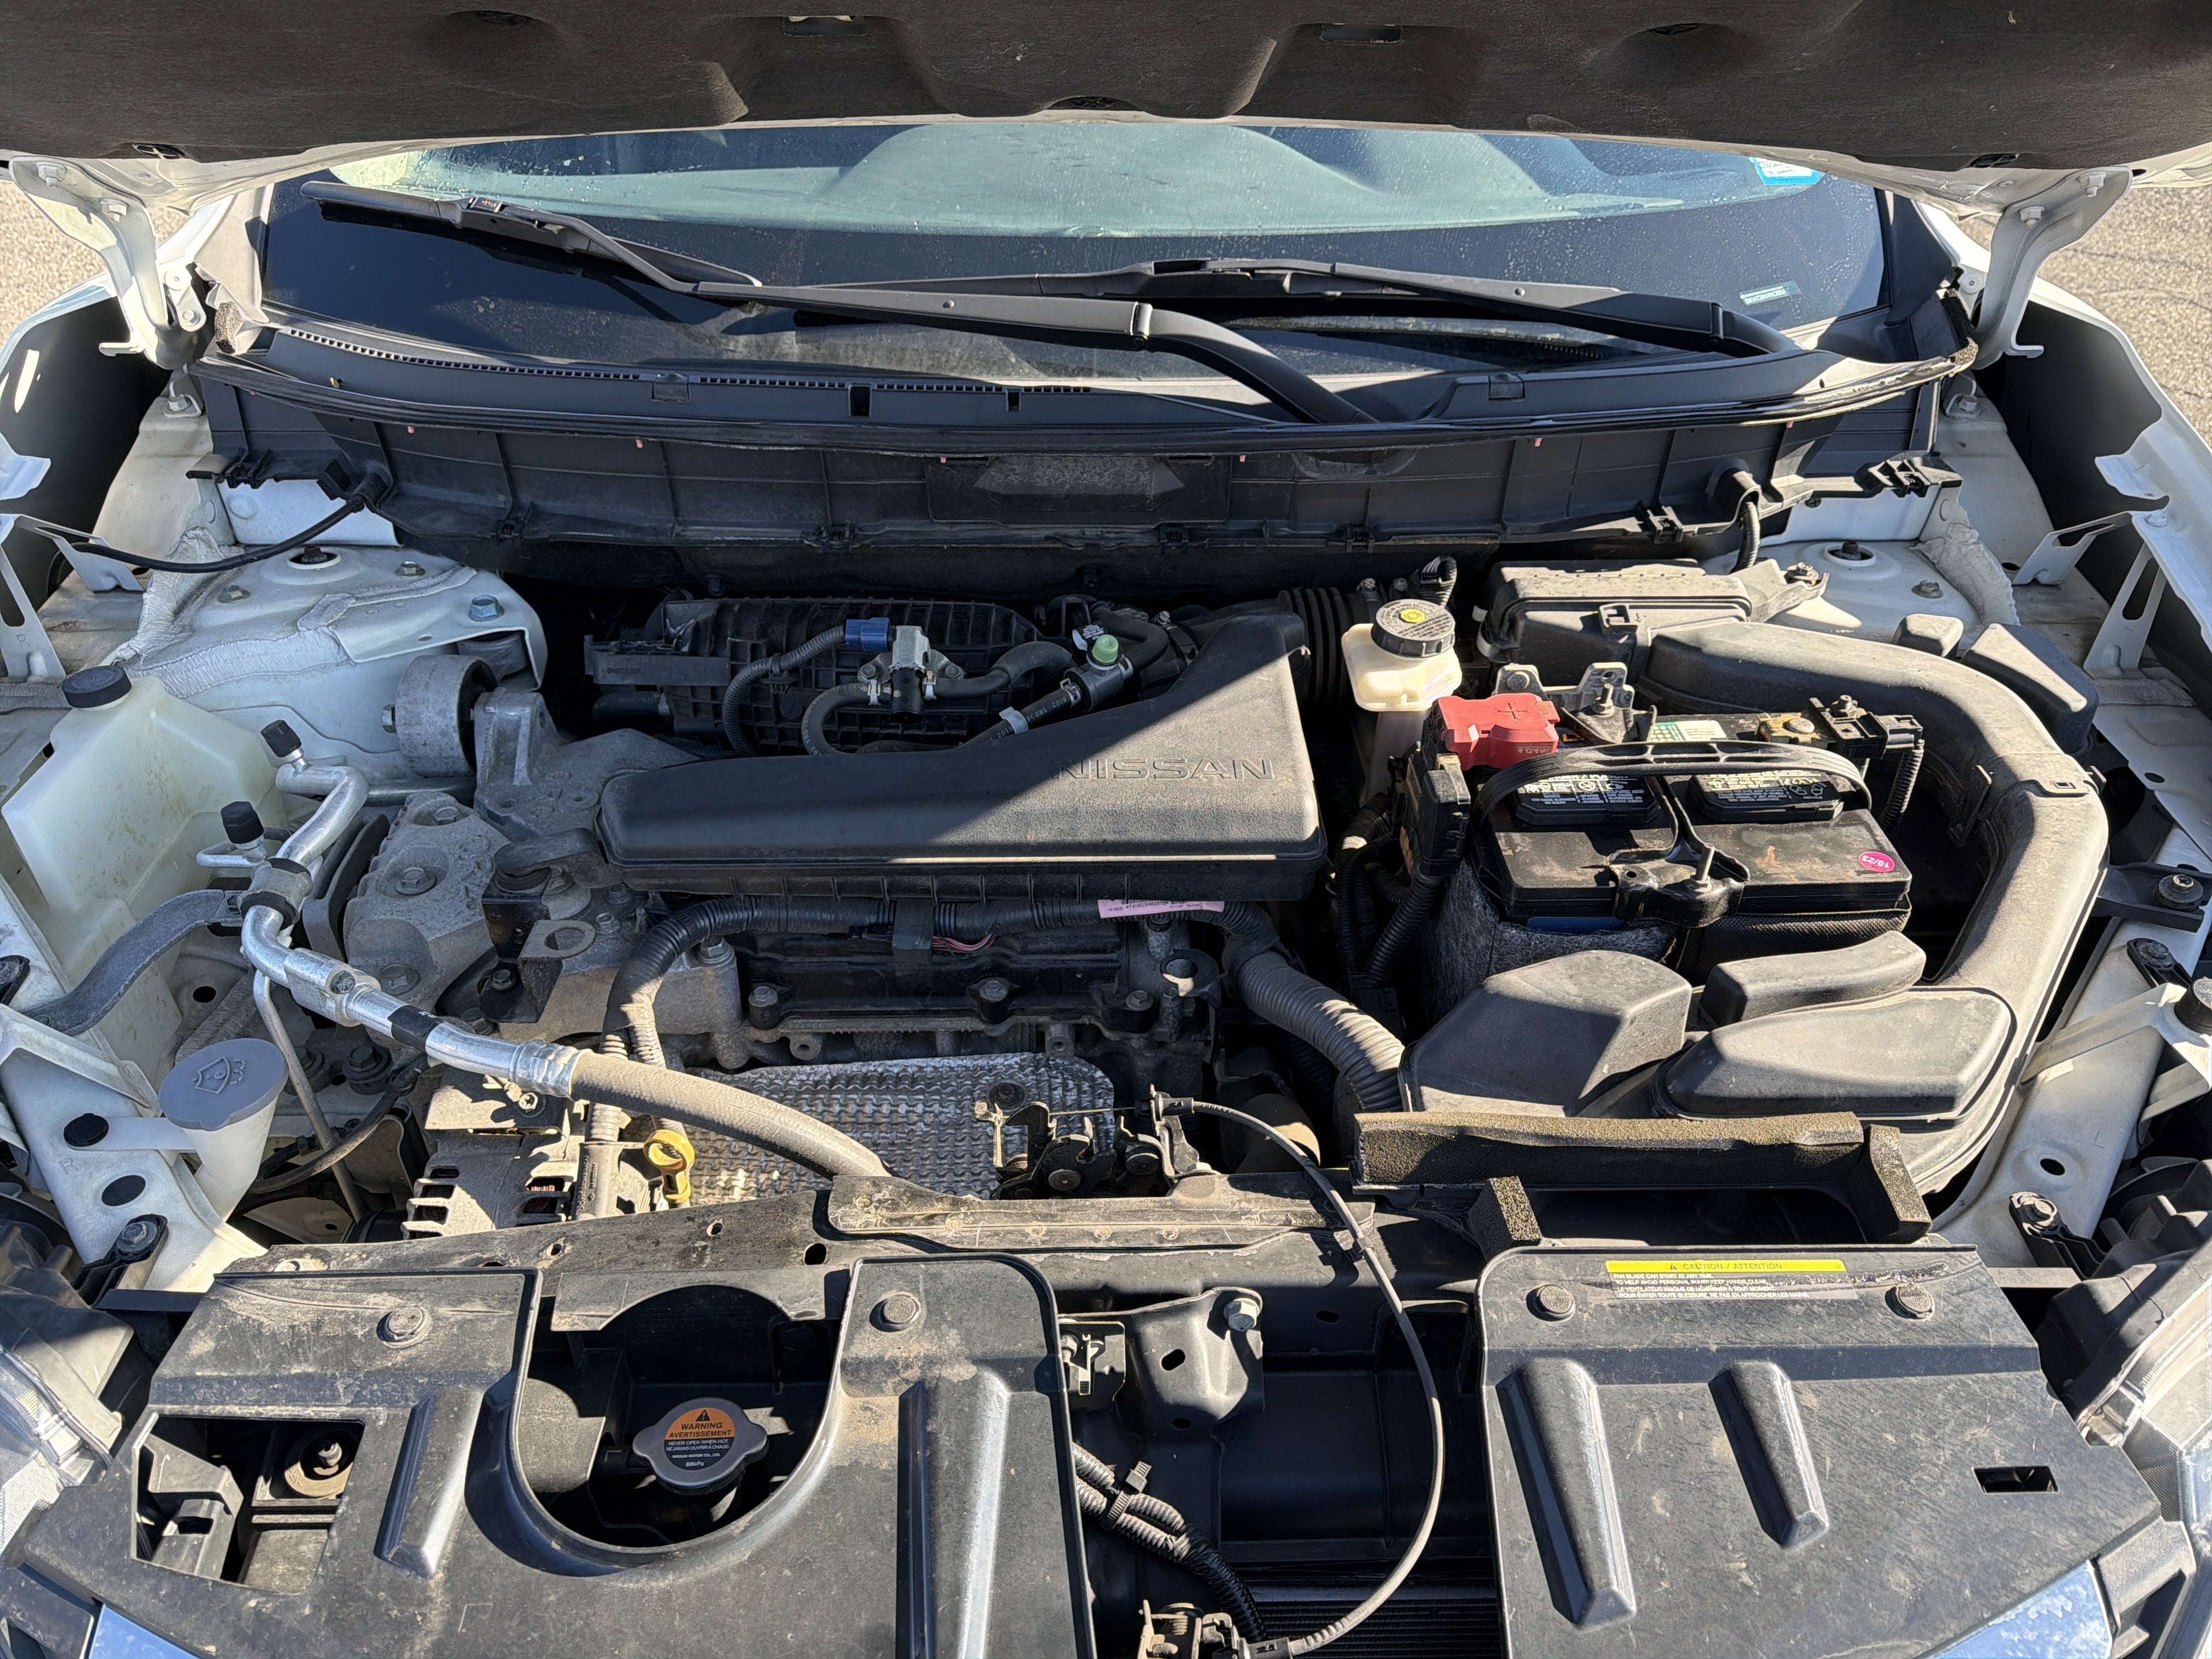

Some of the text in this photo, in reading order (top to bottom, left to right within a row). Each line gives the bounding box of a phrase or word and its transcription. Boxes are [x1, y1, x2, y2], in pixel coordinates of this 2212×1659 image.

[1052, 758, 1274, 780] NISSAN
[1861, 855, 1890, 868] 10/23
[681, 1422, 723, 1430] WARNING
[669, 1430, 732, 1438] AVERTISSEMENT
